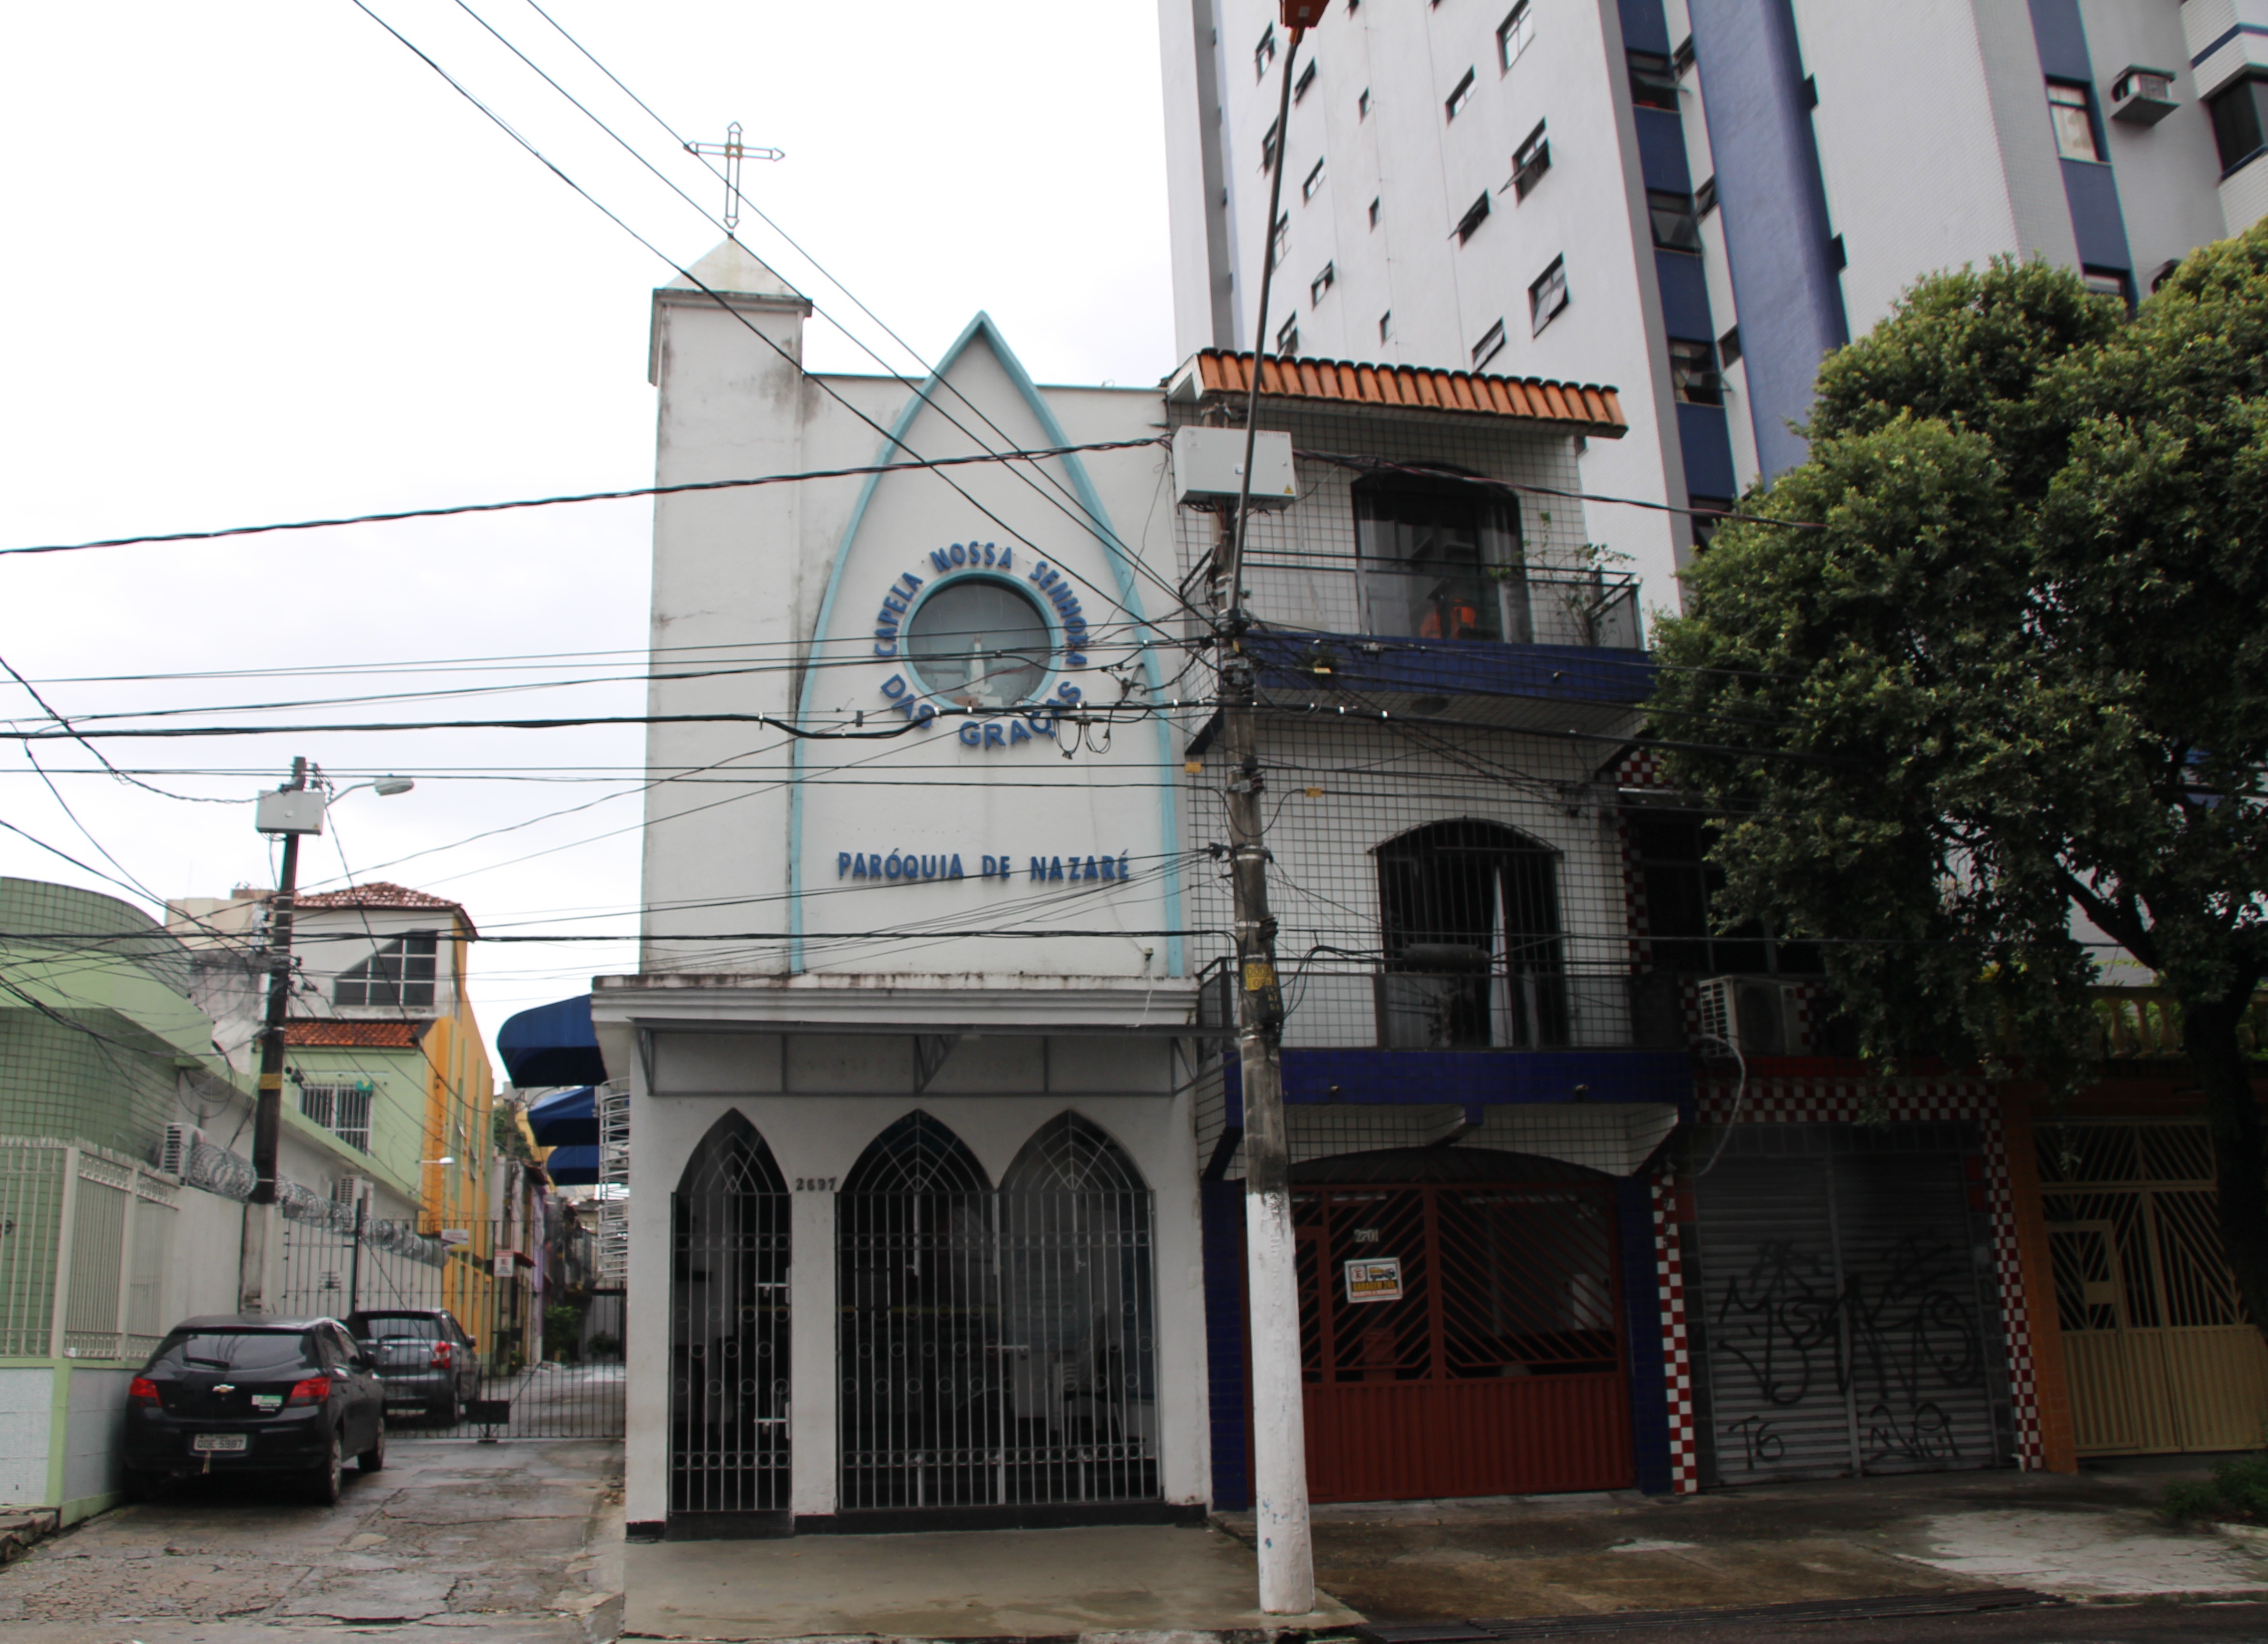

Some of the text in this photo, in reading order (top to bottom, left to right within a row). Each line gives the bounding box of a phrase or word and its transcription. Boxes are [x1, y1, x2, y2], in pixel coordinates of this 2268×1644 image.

[874, 541, 1089, 666] CAPELA NOSSA SENHORA
[880, 674, 1082, 749] DAS GRAÇAS
[838, 848, 1130, 881] PARÓQUIA DE NAZARÉ
[796, 1177, 837, 1191] 2697
[1354, 1229, 1379, 1243] 2701
